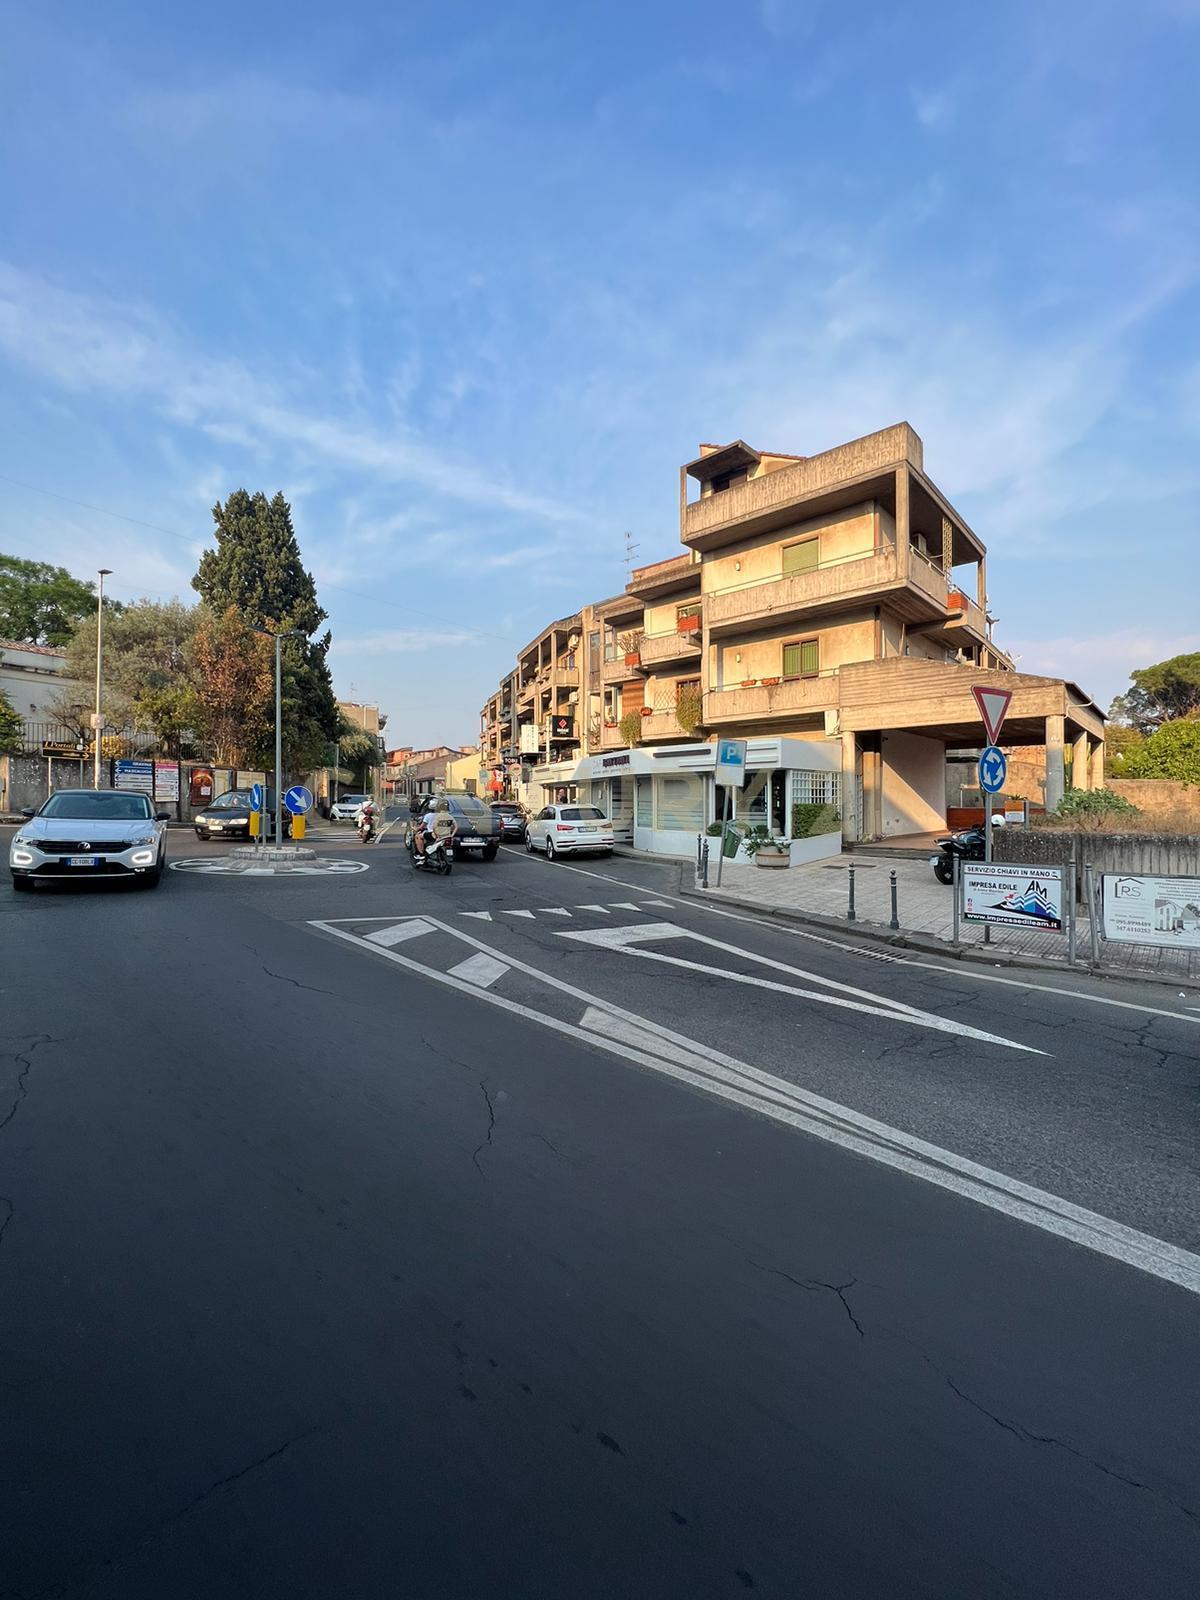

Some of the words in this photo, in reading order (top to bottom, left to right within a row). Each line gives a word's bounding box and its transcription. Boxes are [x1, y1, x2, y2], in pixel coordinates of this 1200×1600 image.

[727, 746, 736, 760] P
[967, 866, 996, 874] SERVIZIO
[969, 881, 997, 889] IMPRESA
[998, 883, 1018, 891] EDILE
[967, 913, 1058, 928] www.impresaedileam.it
